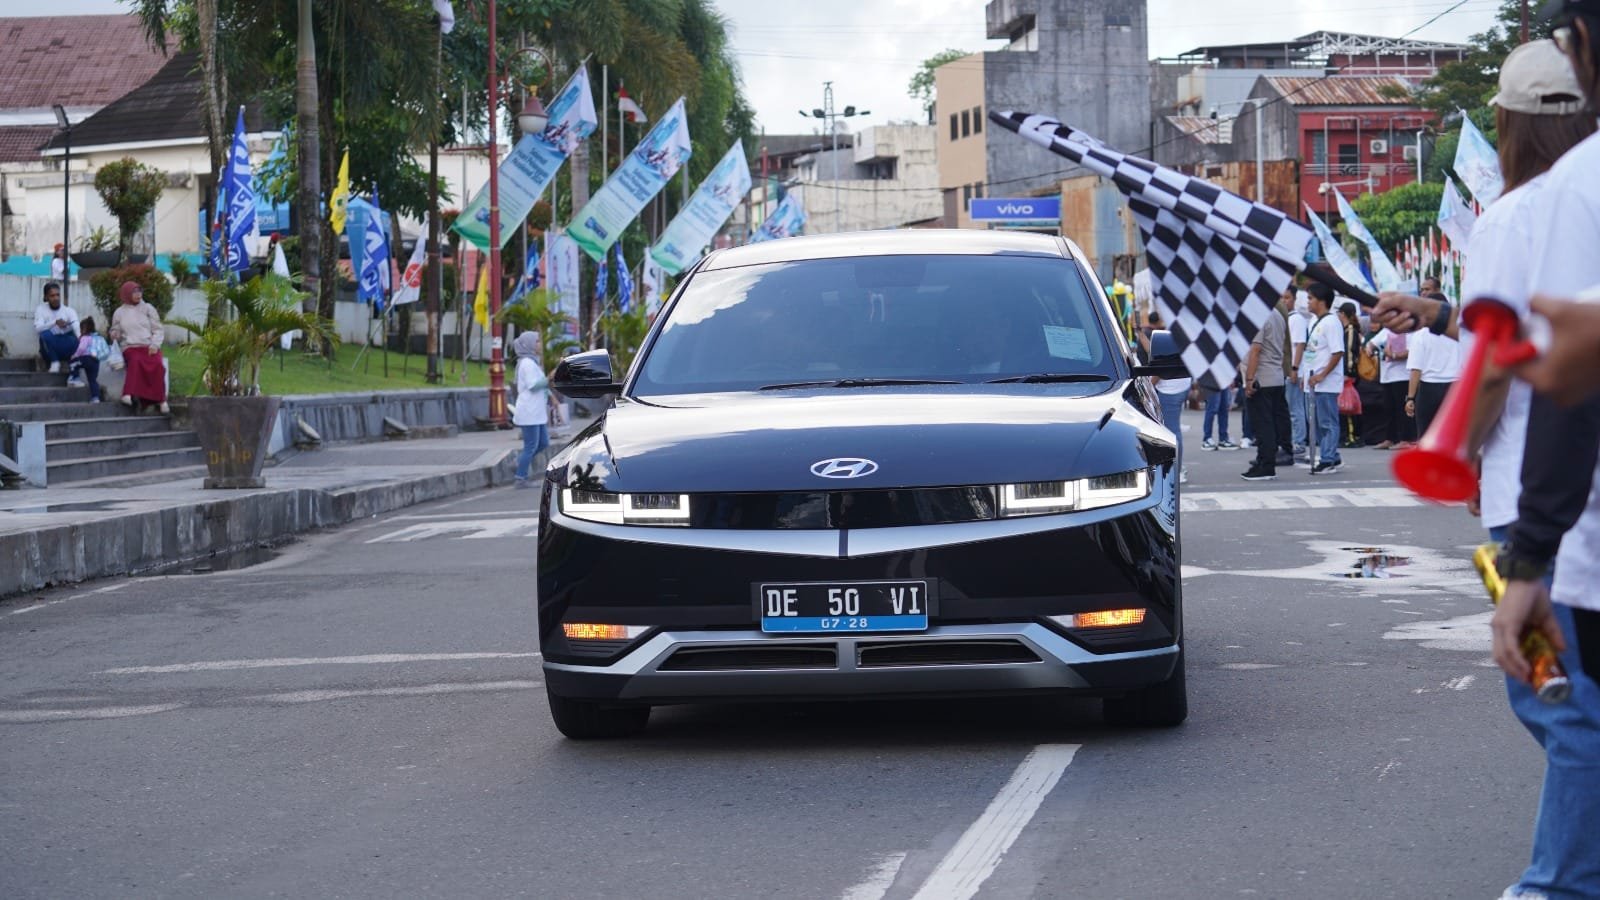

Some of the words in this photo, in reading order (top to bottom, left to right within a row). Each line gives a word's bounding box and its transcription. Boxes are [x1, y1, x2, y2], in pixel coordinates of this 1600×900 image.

[997, 203, 1034, 214] vivo
[766, 589, 798, 617] DE
[828, 588, 860, 616] 50
[890, 587, 920, 615] VI
